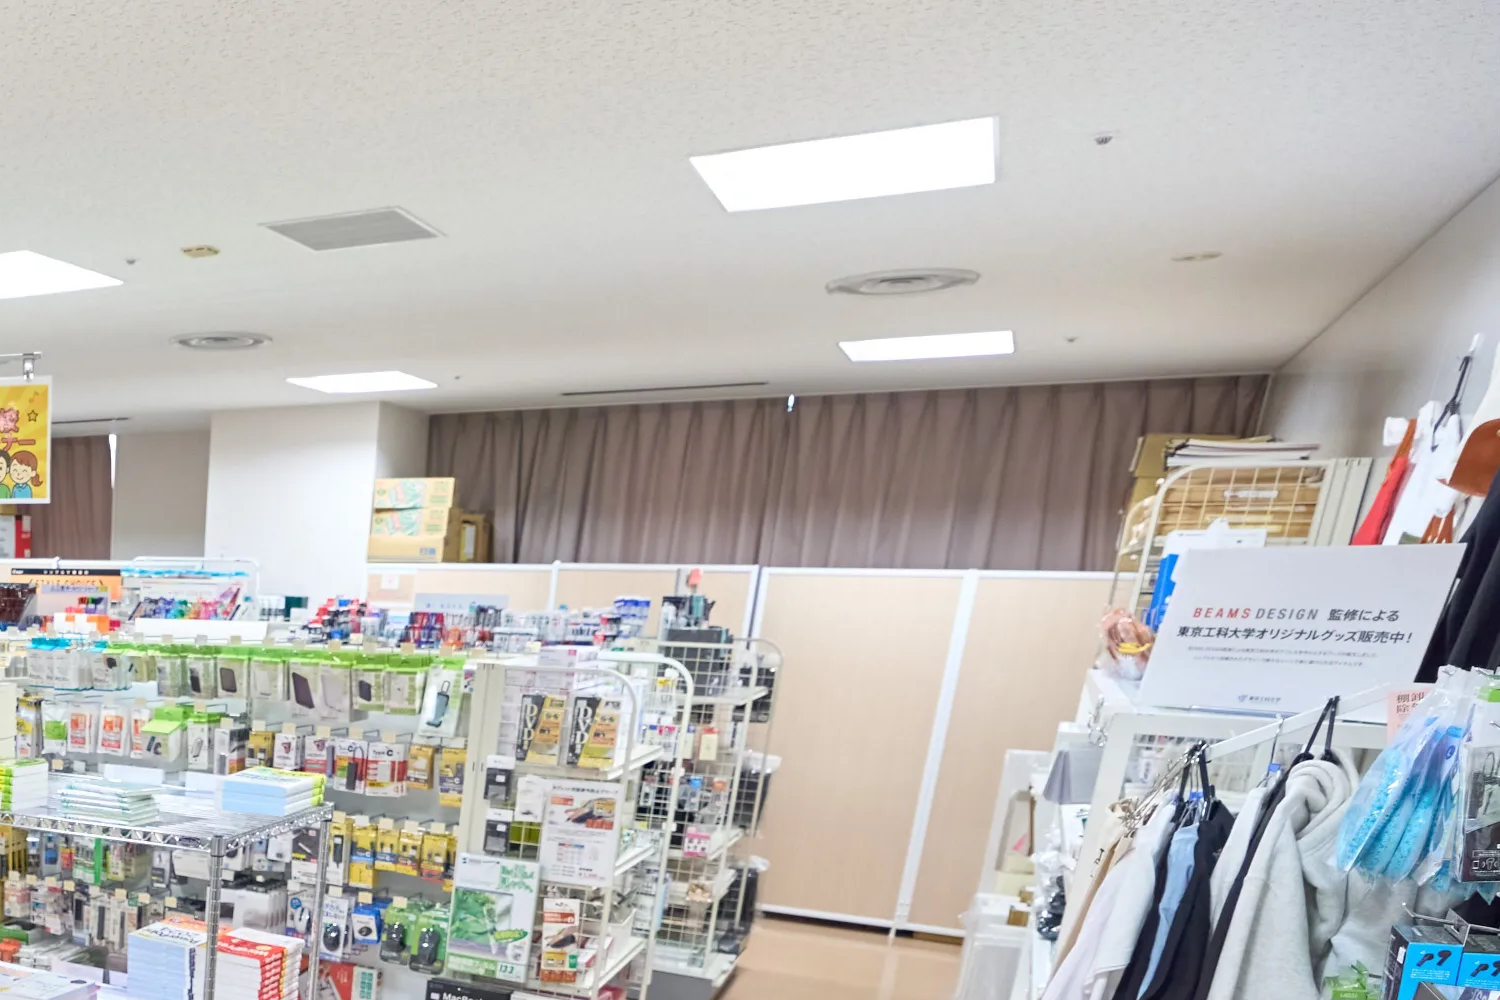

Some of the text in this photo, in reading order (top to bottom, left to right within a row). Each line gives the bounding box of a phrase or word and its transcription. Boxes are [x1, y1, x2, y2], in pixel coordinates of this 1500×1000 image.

[1192, 607, 1400, 623] BEAMS DESIGN 監修による
[1176, 624, 1414, 645] 東京工科大学オリジナルグッズ販売中!
